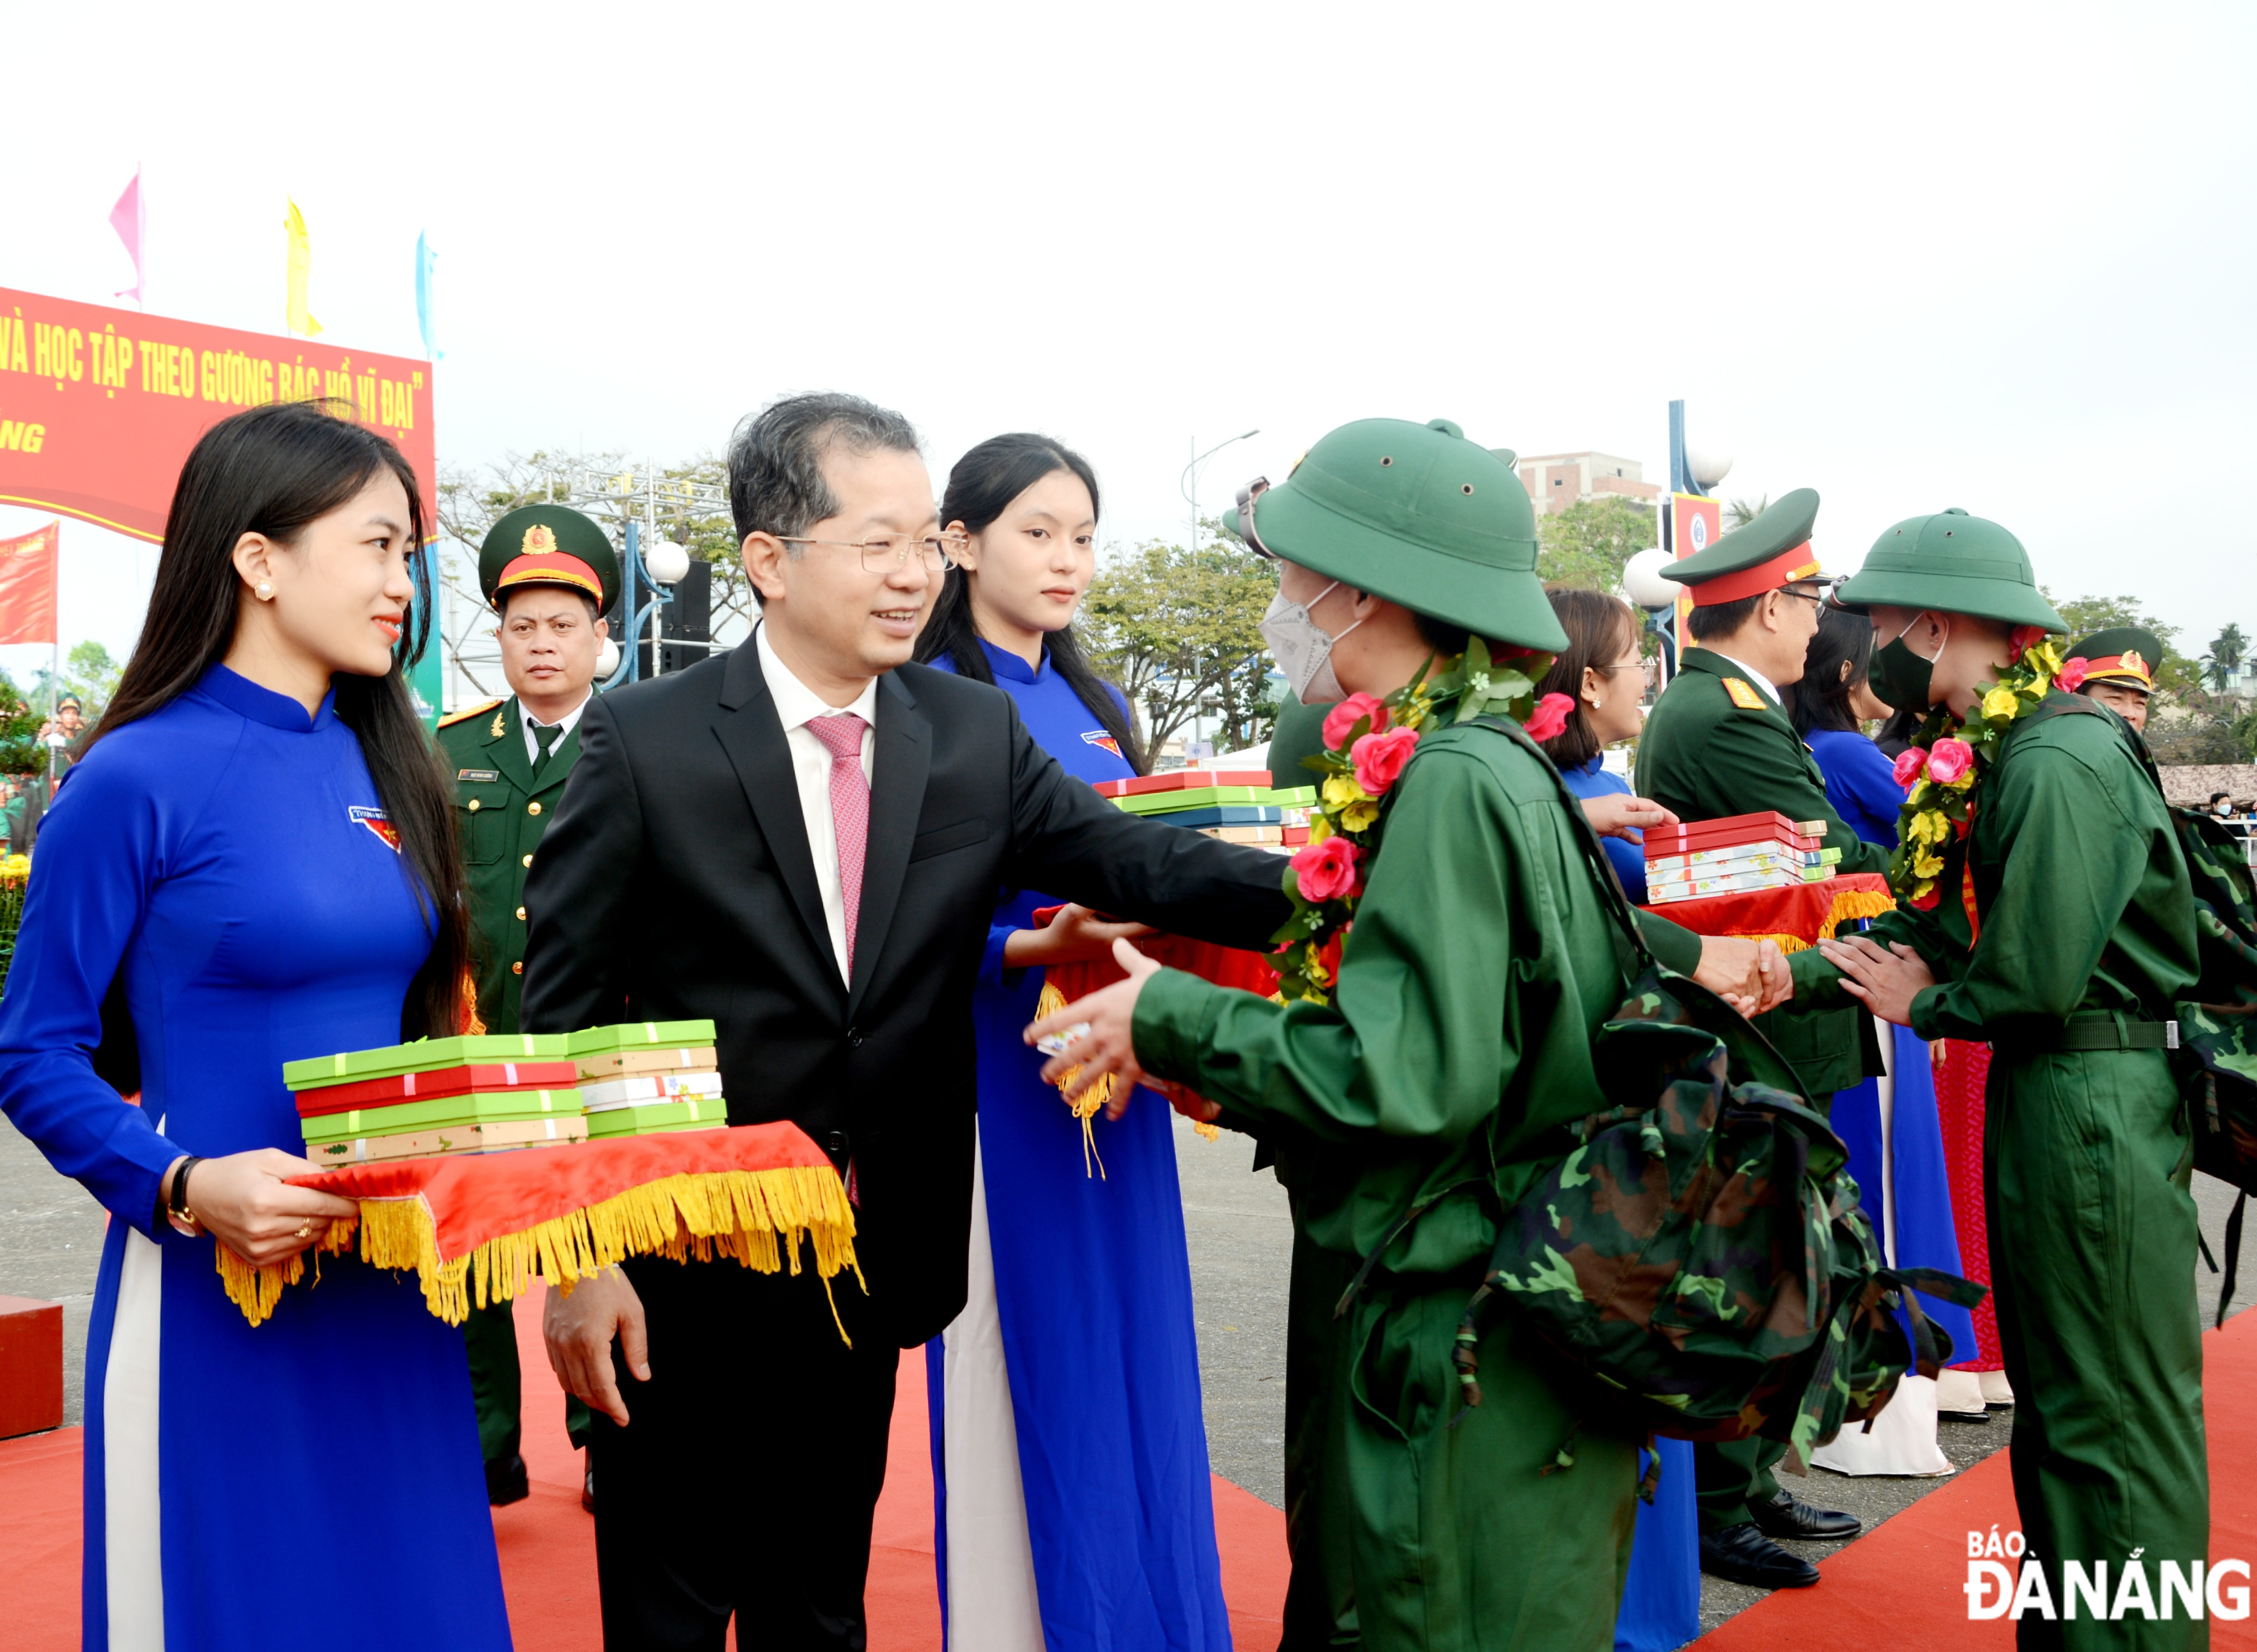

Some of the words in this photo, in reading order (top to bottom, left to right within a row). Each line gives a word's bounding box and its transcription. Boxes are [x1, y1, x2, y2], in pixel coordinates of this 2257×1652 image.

[0, 306, 29, 373] VÀ
[34, 321, 83, 391] HỌC
[89, 323, 133, 399] TẬP
[139, 340, 194, 398] THEO
[201, 348, 273, 406] GƯƠNG
[356, 367, 376, 424] VĨ
[0, 419, 46, 453] NG
